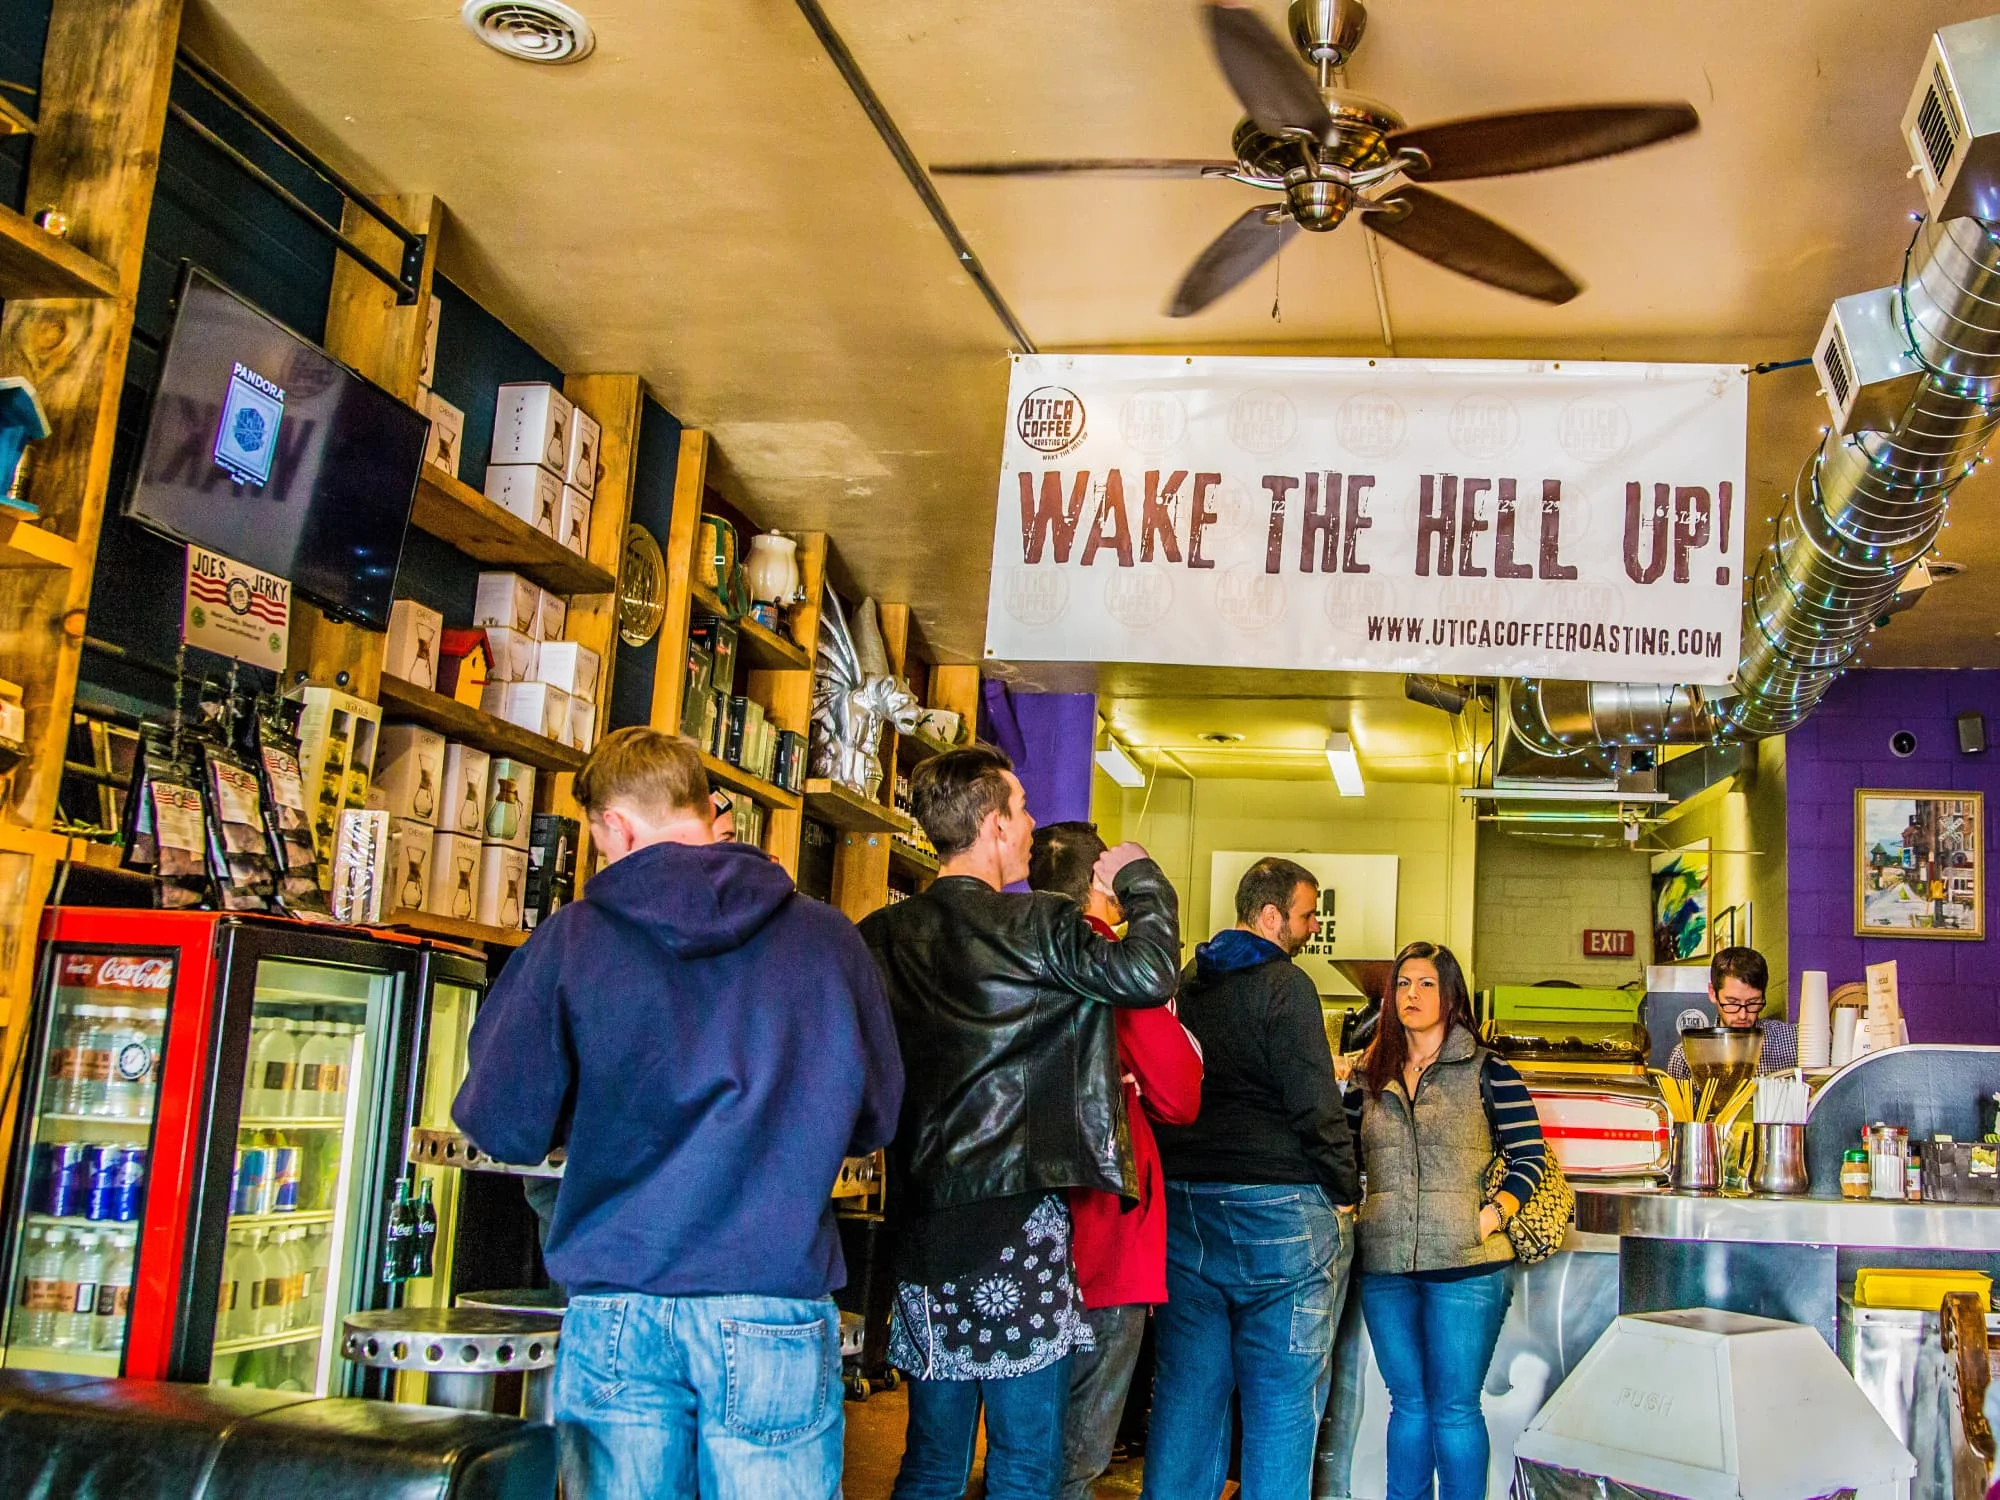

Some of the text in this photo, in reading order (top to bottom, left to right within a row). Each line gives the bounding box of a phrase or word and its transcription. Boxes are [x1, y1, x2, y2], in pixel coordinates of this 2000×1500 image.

[234, 362, 286, 402] PANDORA
[1023, 420, 1072, 438] COFFEE
[1060, 449, 1070, 457] THE
[1018, 468, 1732, 585] WAKE THE HELL UP!
[252, 574, 288, 603] JERKY
[1367, 615, 1722, 658] WWW.UTICACOFFEEROASTING.COM
[1591, 932, 1628, 953] EXIT
[1616, 1387, 1675, 1416] PUSH
